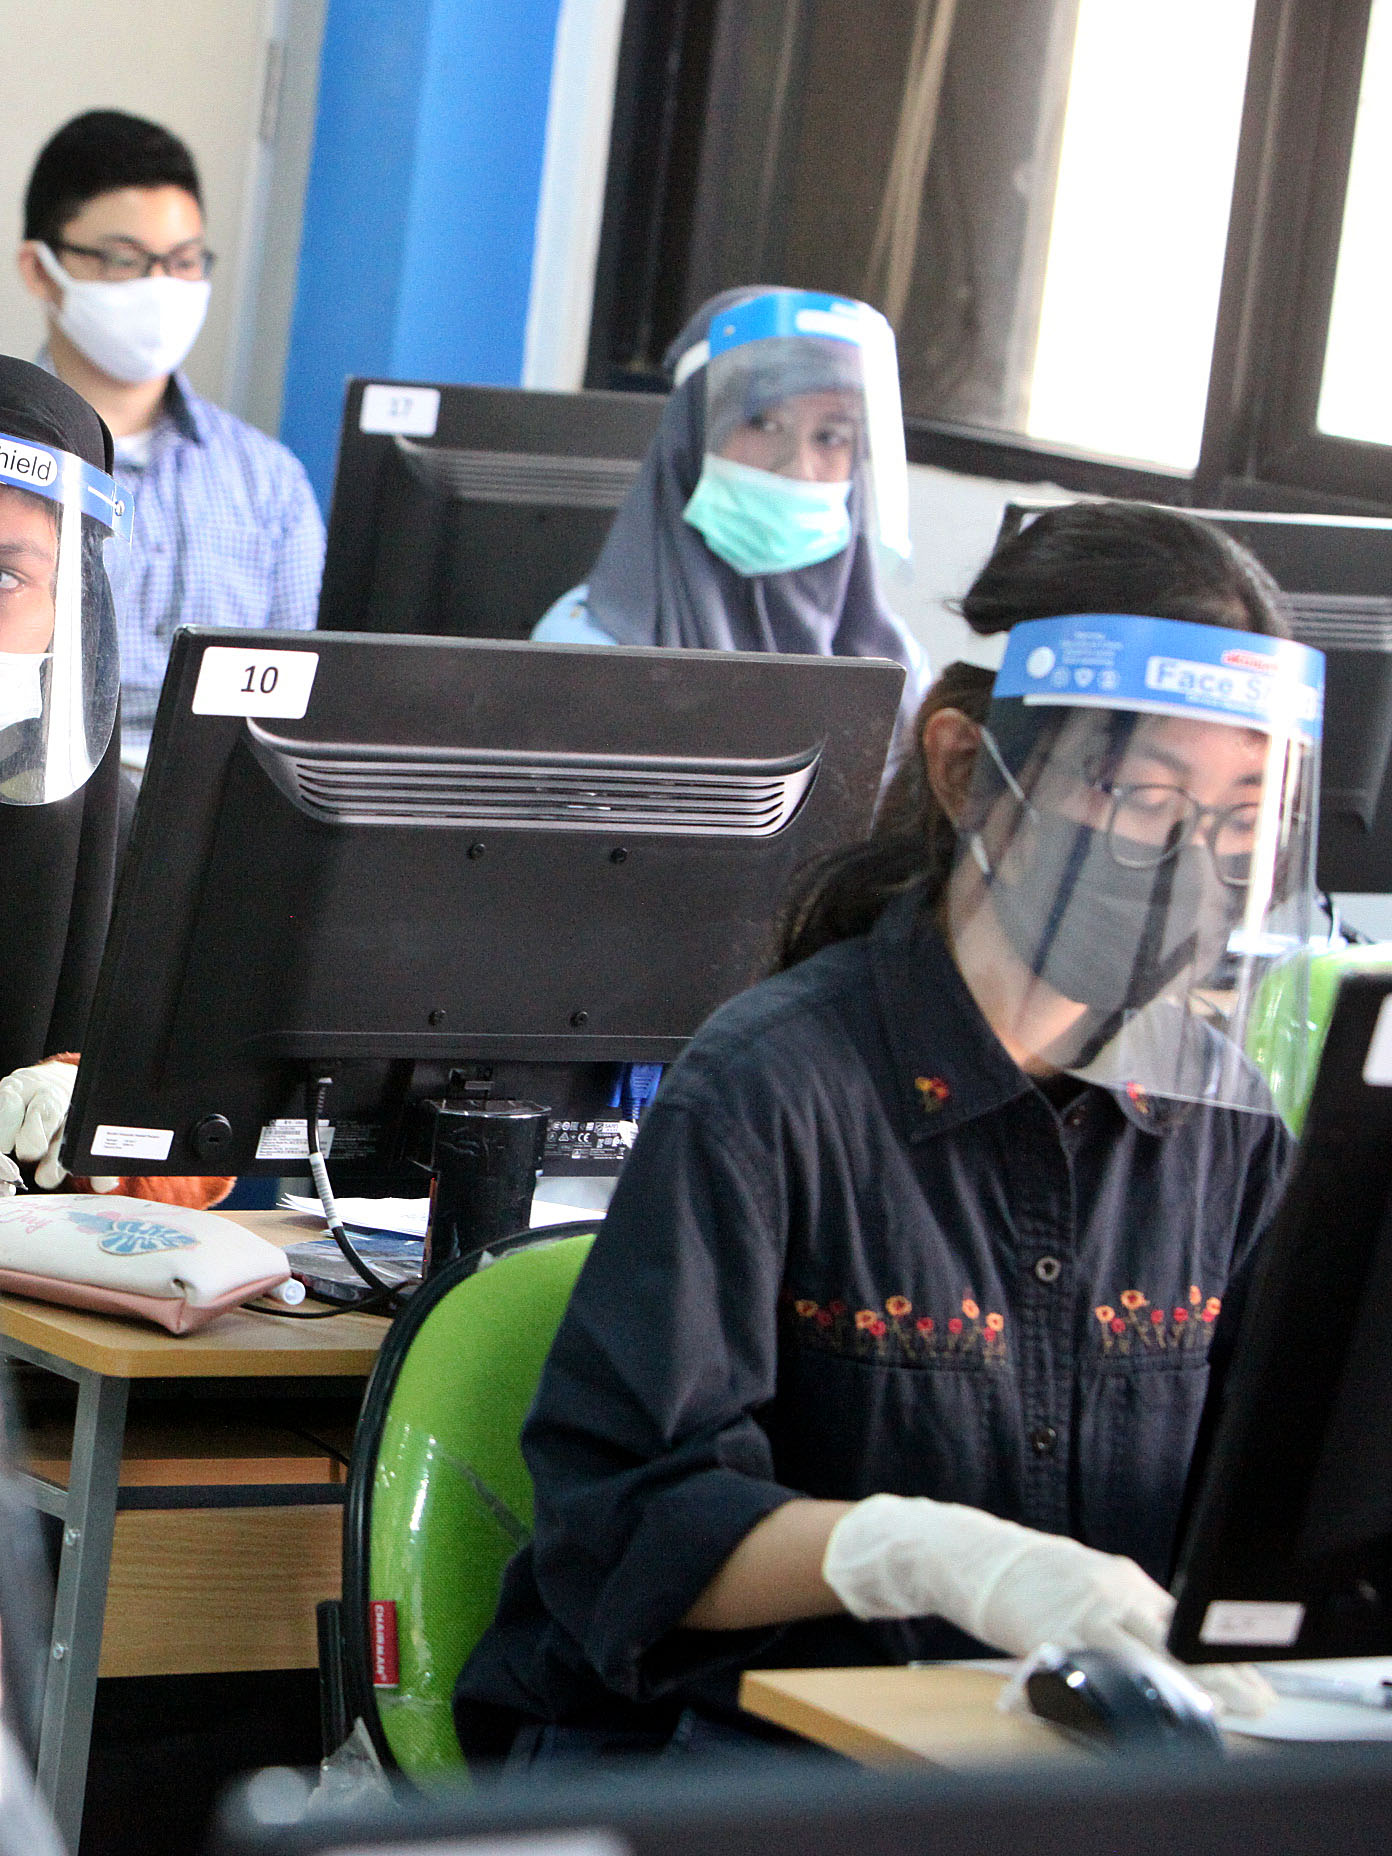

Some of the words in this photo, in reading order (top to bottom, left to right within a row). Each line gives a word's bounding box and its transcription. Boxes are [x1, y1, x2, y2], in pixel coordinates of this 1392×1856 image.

[389, 397, 414, 417] 17
[240, 665, 279, 694] 10
[1157, 660, 1234, 698] Face
[374, 1604, 385, 1675] CHAIRMAN
